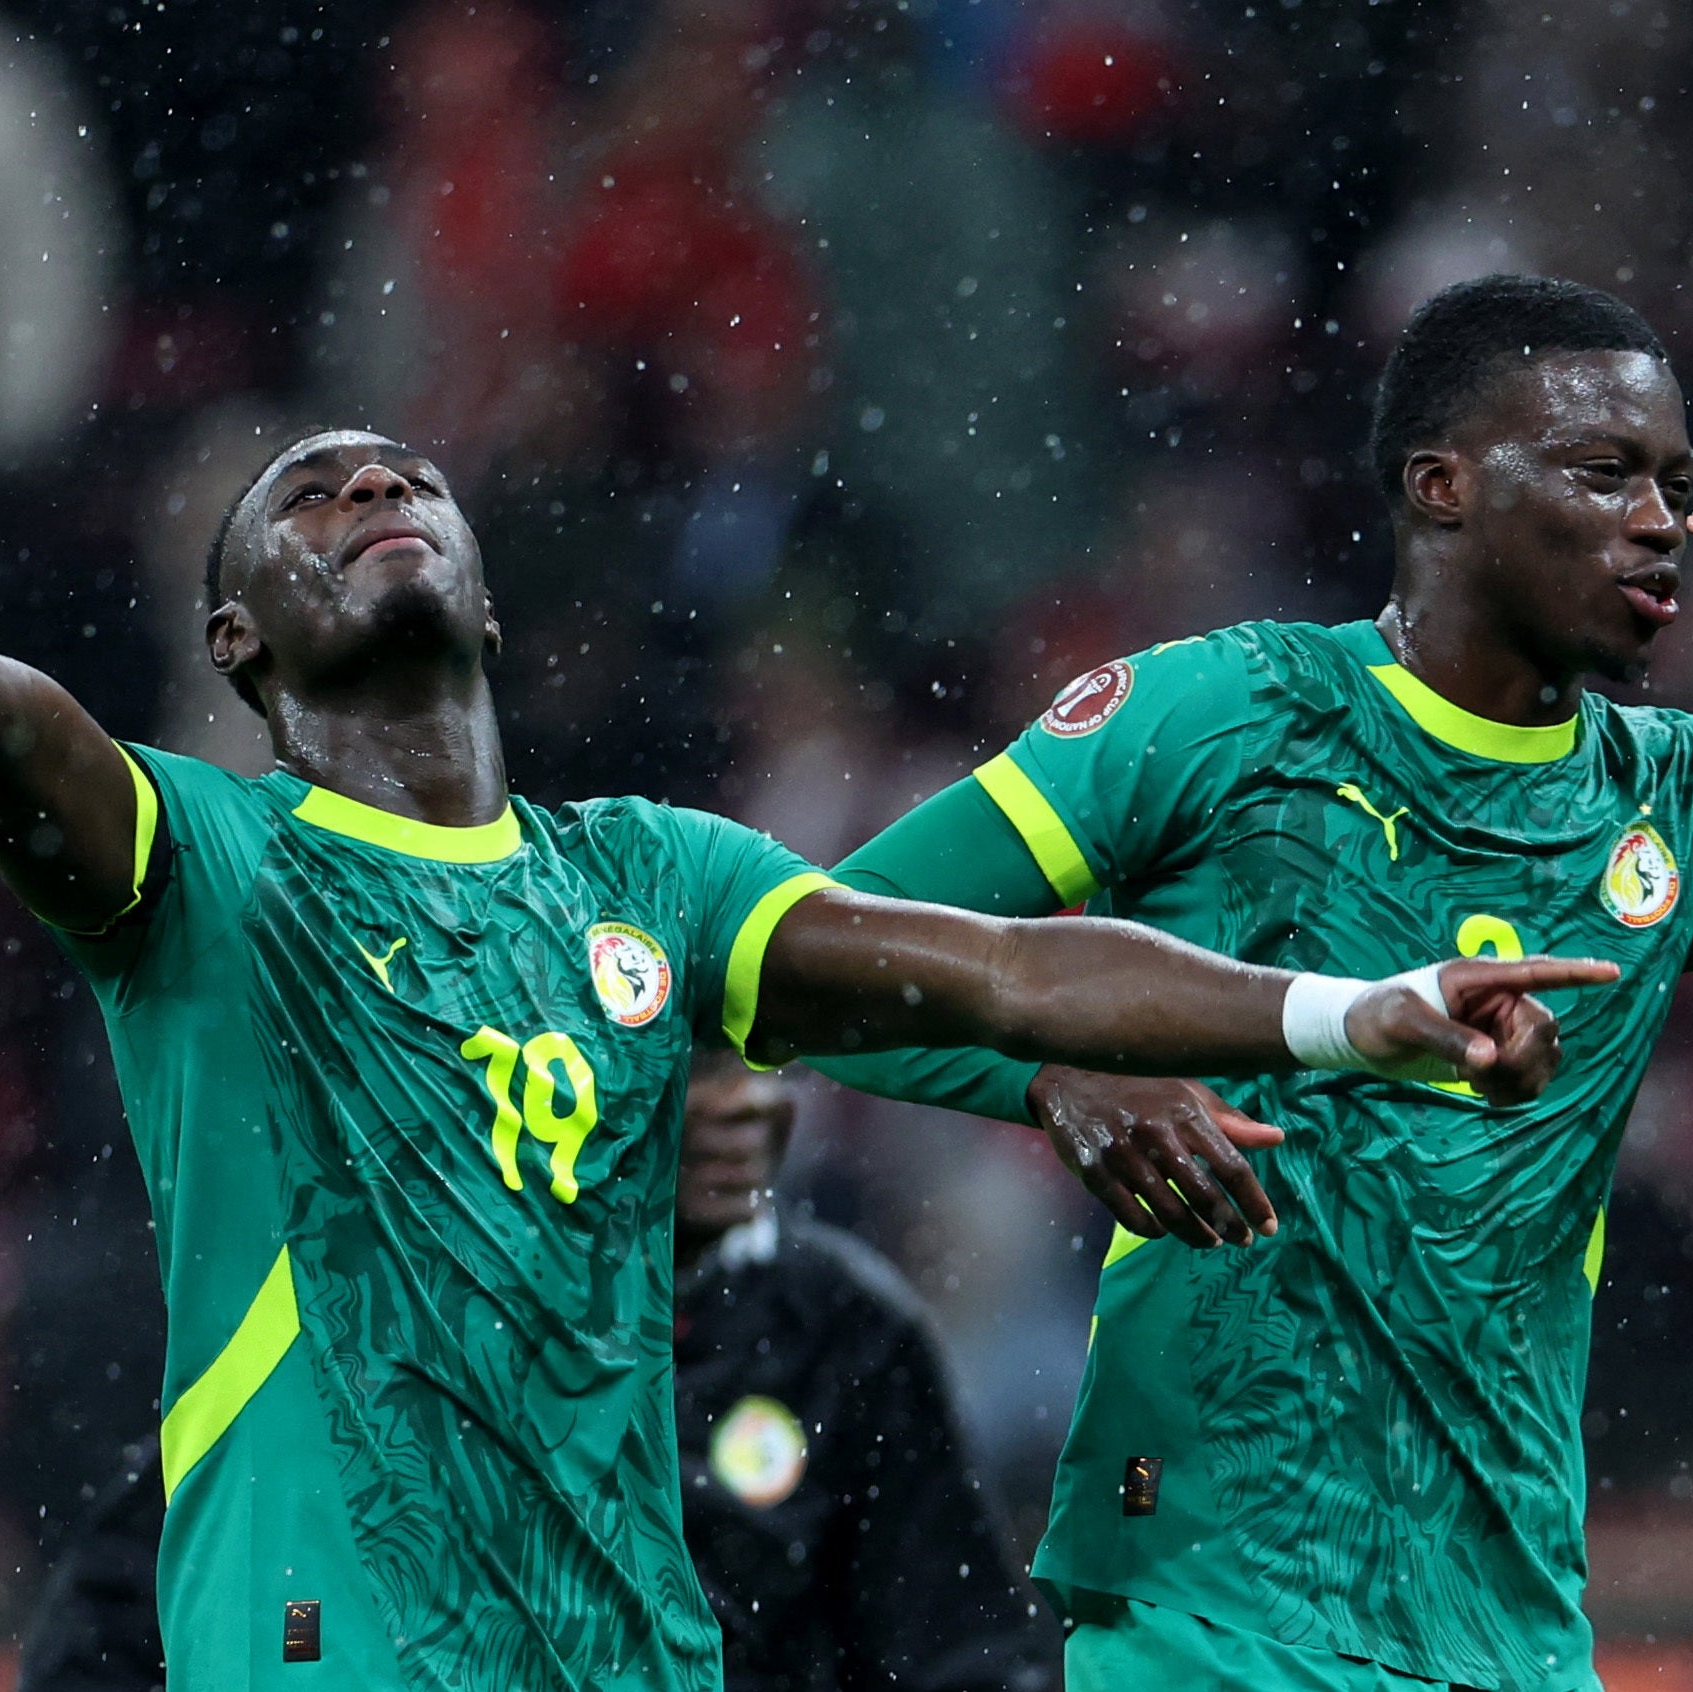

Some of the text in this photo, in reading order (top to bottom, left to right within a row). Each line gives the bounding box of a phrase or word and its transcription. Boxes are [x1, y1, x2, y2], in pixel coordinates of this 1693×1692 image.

[1102, 697, 1120, 717] CUP
[1088, 714, 1103, 727] OF
[460, 1025, 598, 1204] 19
